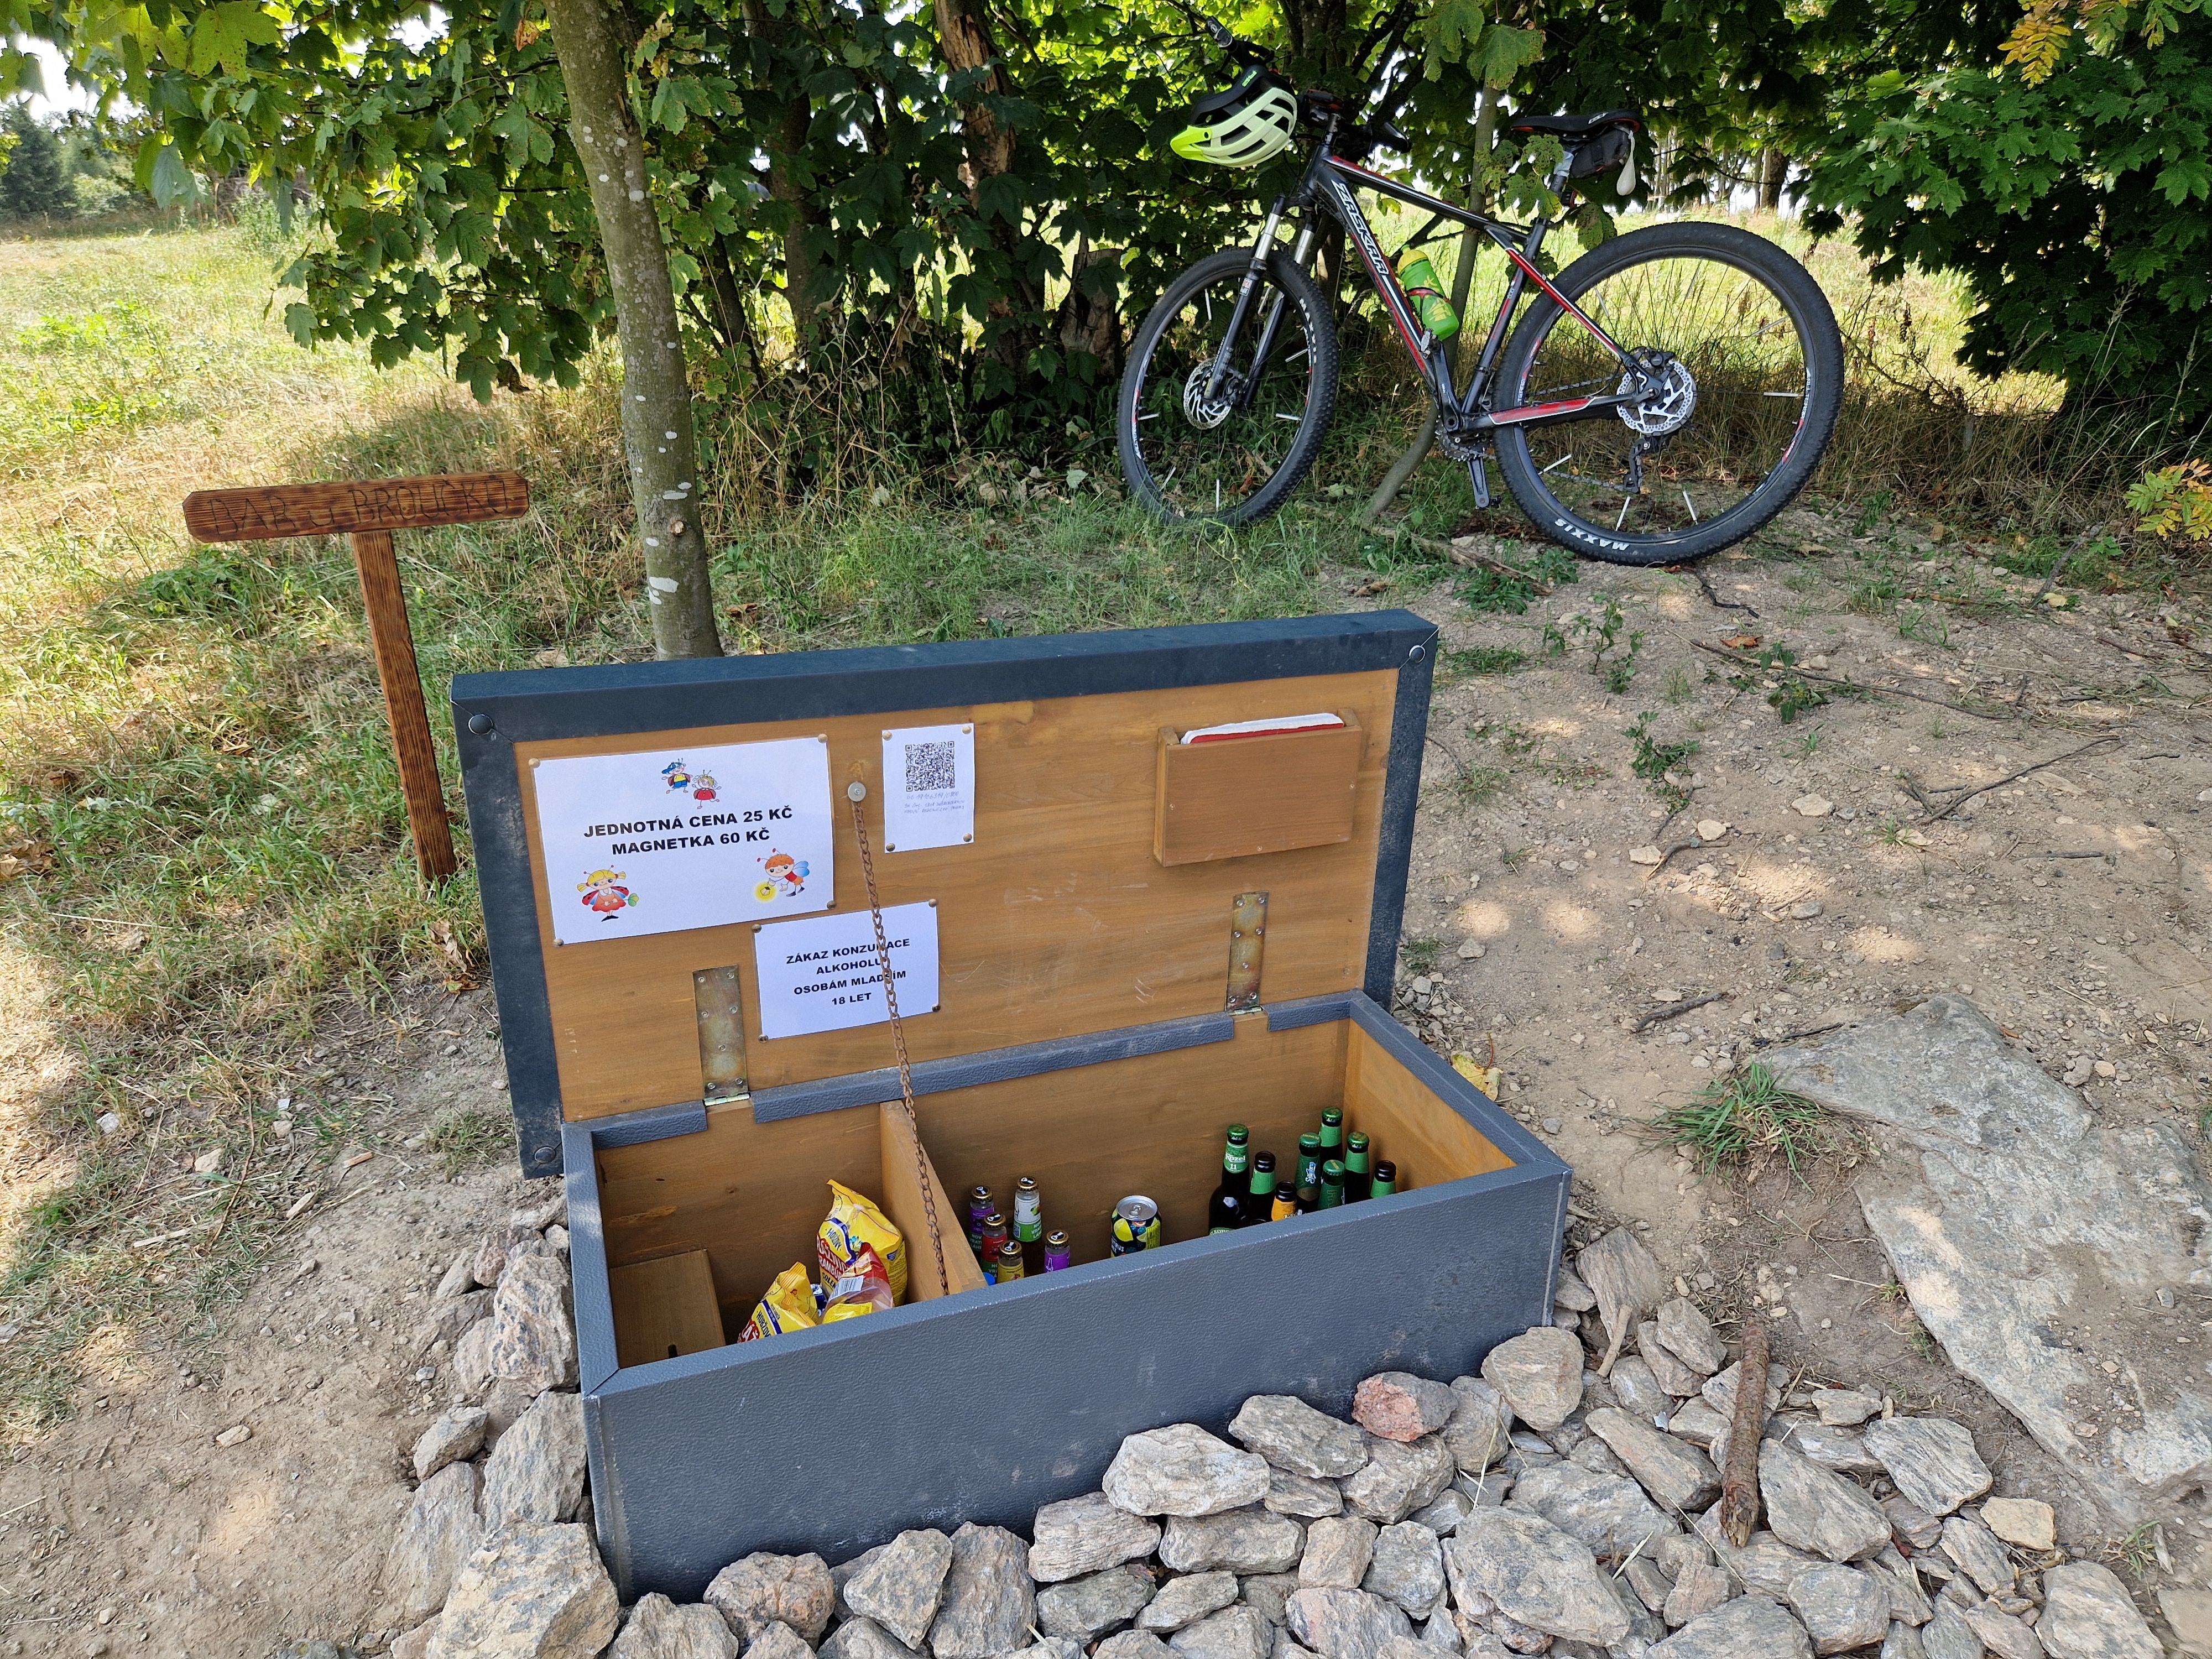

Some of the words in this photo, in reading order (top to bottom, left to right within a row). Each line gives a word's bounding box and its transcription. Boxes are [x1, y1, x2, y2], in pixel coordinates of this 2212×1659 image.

[1554, 519, 1630, 551] MAXXIS
[583, 815, 683, 838] JEDNOTNÁ
[688, 812, 738, 828] CENA
[743, 810, 763, 823] 25
[769, 805, 793, 821] KČ
[612, 834, 714, 855] MAGNETKA
[720, 832, 740, 844] 60
[746, 827, 770, 842] KČ
[786, 951, 828, 964] ZÁKAZ
[832, 938, 910, 957] KONZUACE
[816, 958, 881, 975] ALKOHOLU
[794, 980, 847, 995] OSOBÁM
[831, 997, 846, 1005] 18
[850, 993, 872, 1003] LET
[1225, 1152, 1246, 1163] Kozel
[822, 1272, 836, 1288] SOLEN
